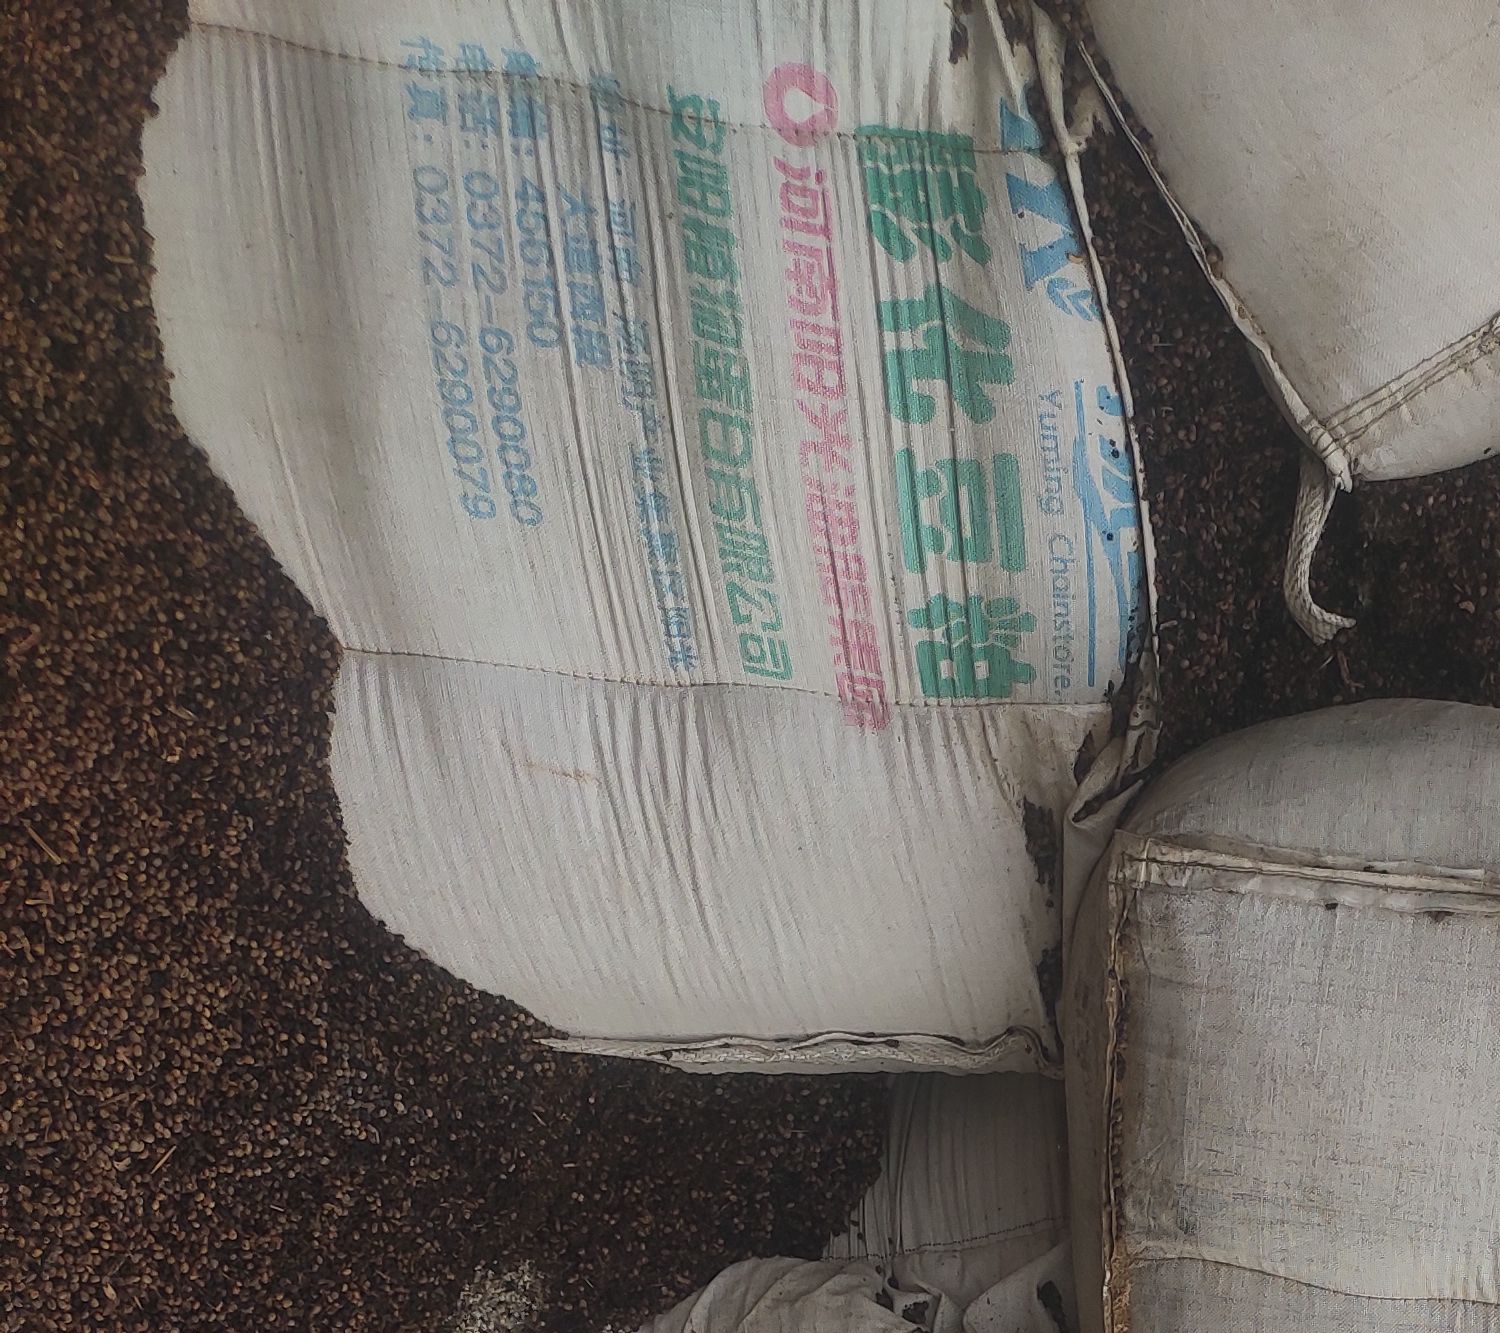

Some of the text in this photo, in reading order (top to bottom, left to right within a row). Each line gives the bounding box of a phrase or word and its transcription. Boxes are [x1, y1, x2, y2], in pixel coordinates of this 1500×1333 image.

[413, 165, 498, 521] 0372-6290079
[462, 170, 545, 528] 0372-6290080
[514, 175, 562, 349] 456150
[665, 84, 794, 680] 安阳植物蛋白有限公司
[854, 125, 1037, 699] 膨化豆粕
[1038, 389, 1069, 515] Yuming
